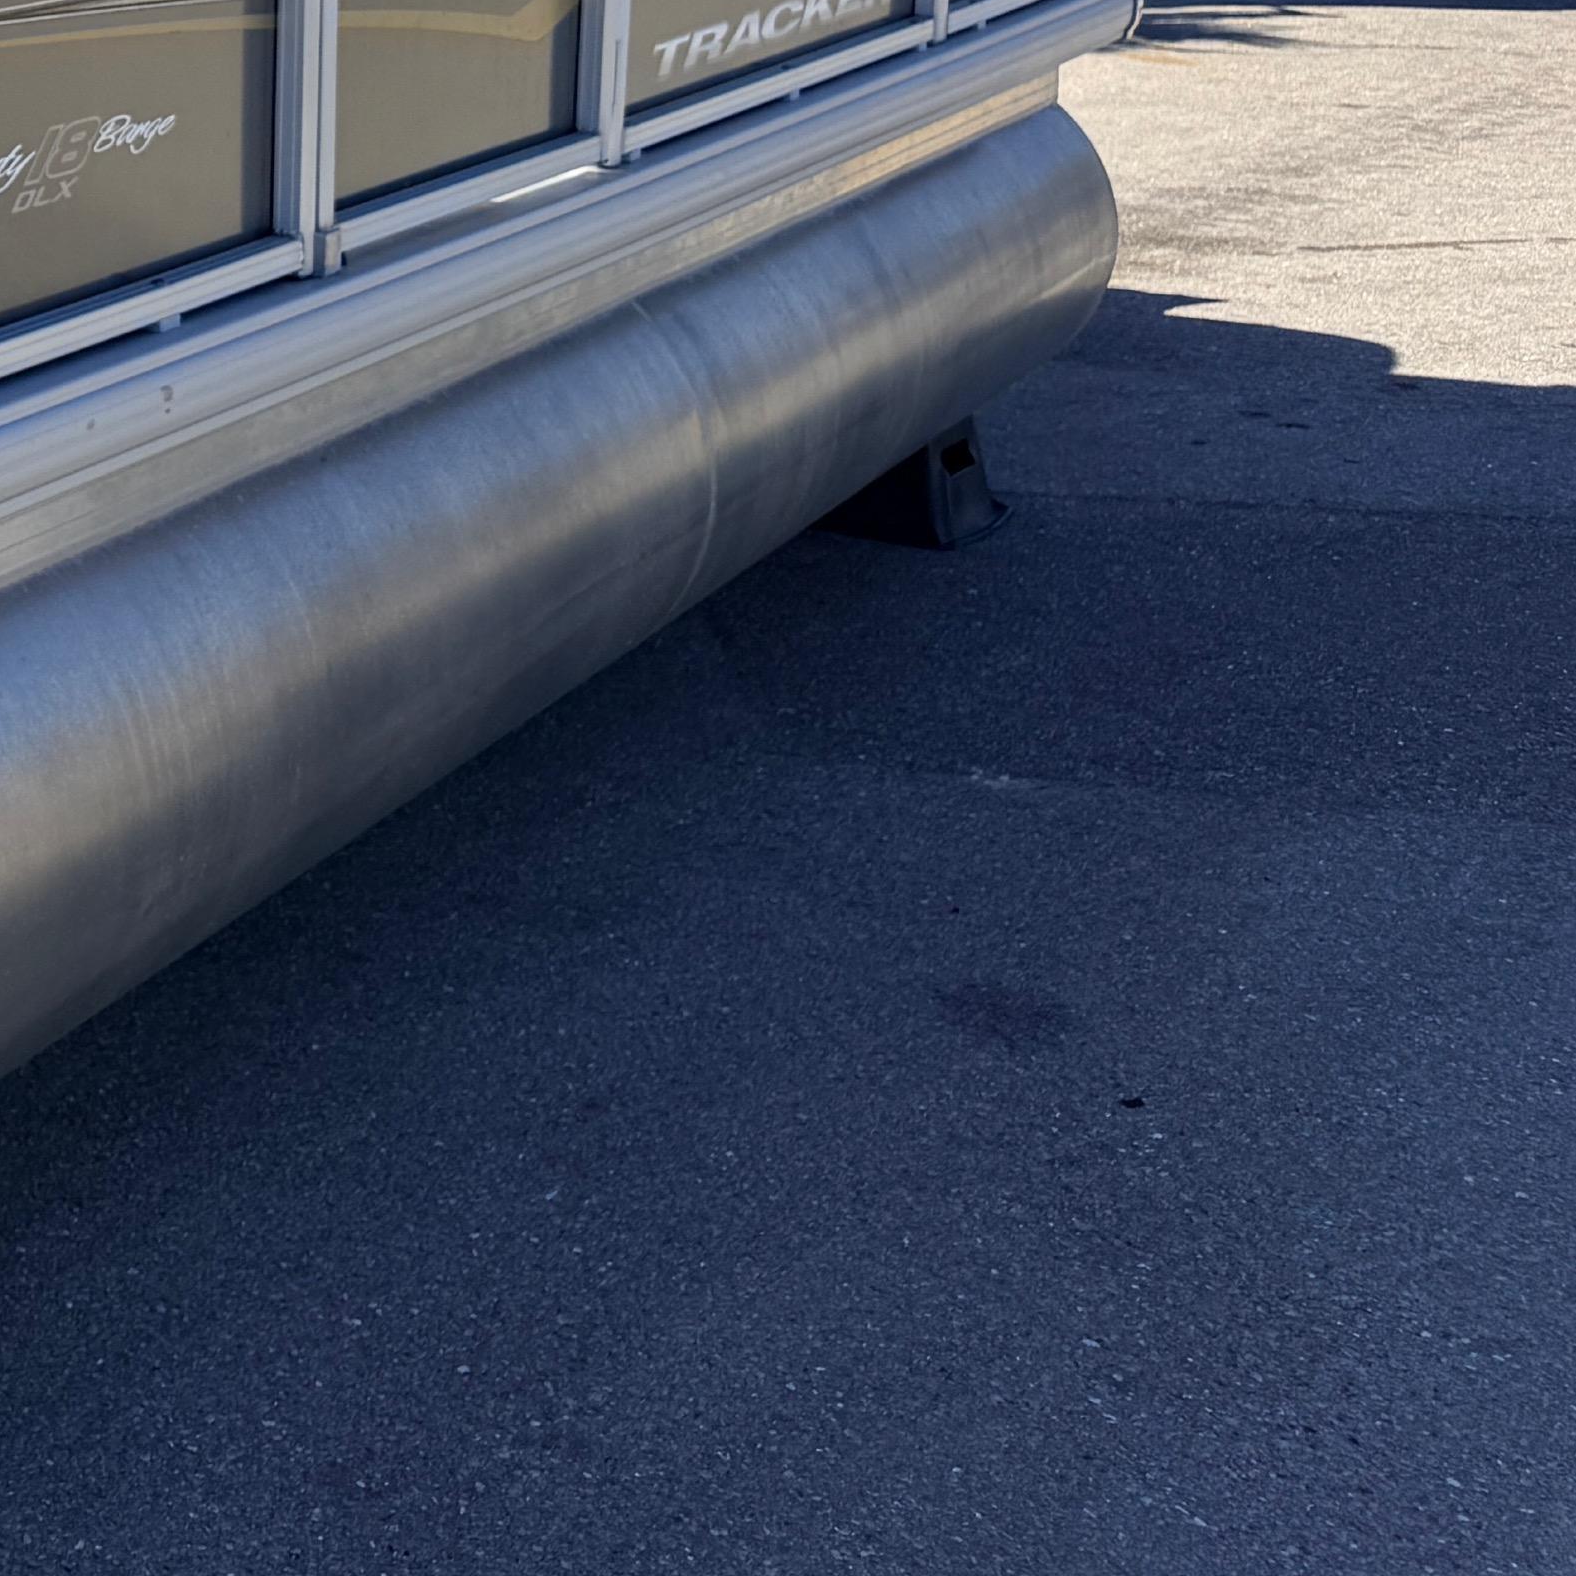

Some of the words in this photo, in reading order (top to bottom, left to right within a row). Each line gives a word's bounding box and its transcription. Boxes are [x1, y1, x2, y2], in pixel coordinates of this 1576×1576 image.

[24, 116, 102, 187] 18
[93, 114, 176, 154] Barge
[11, 176, 79, 214] DLX
